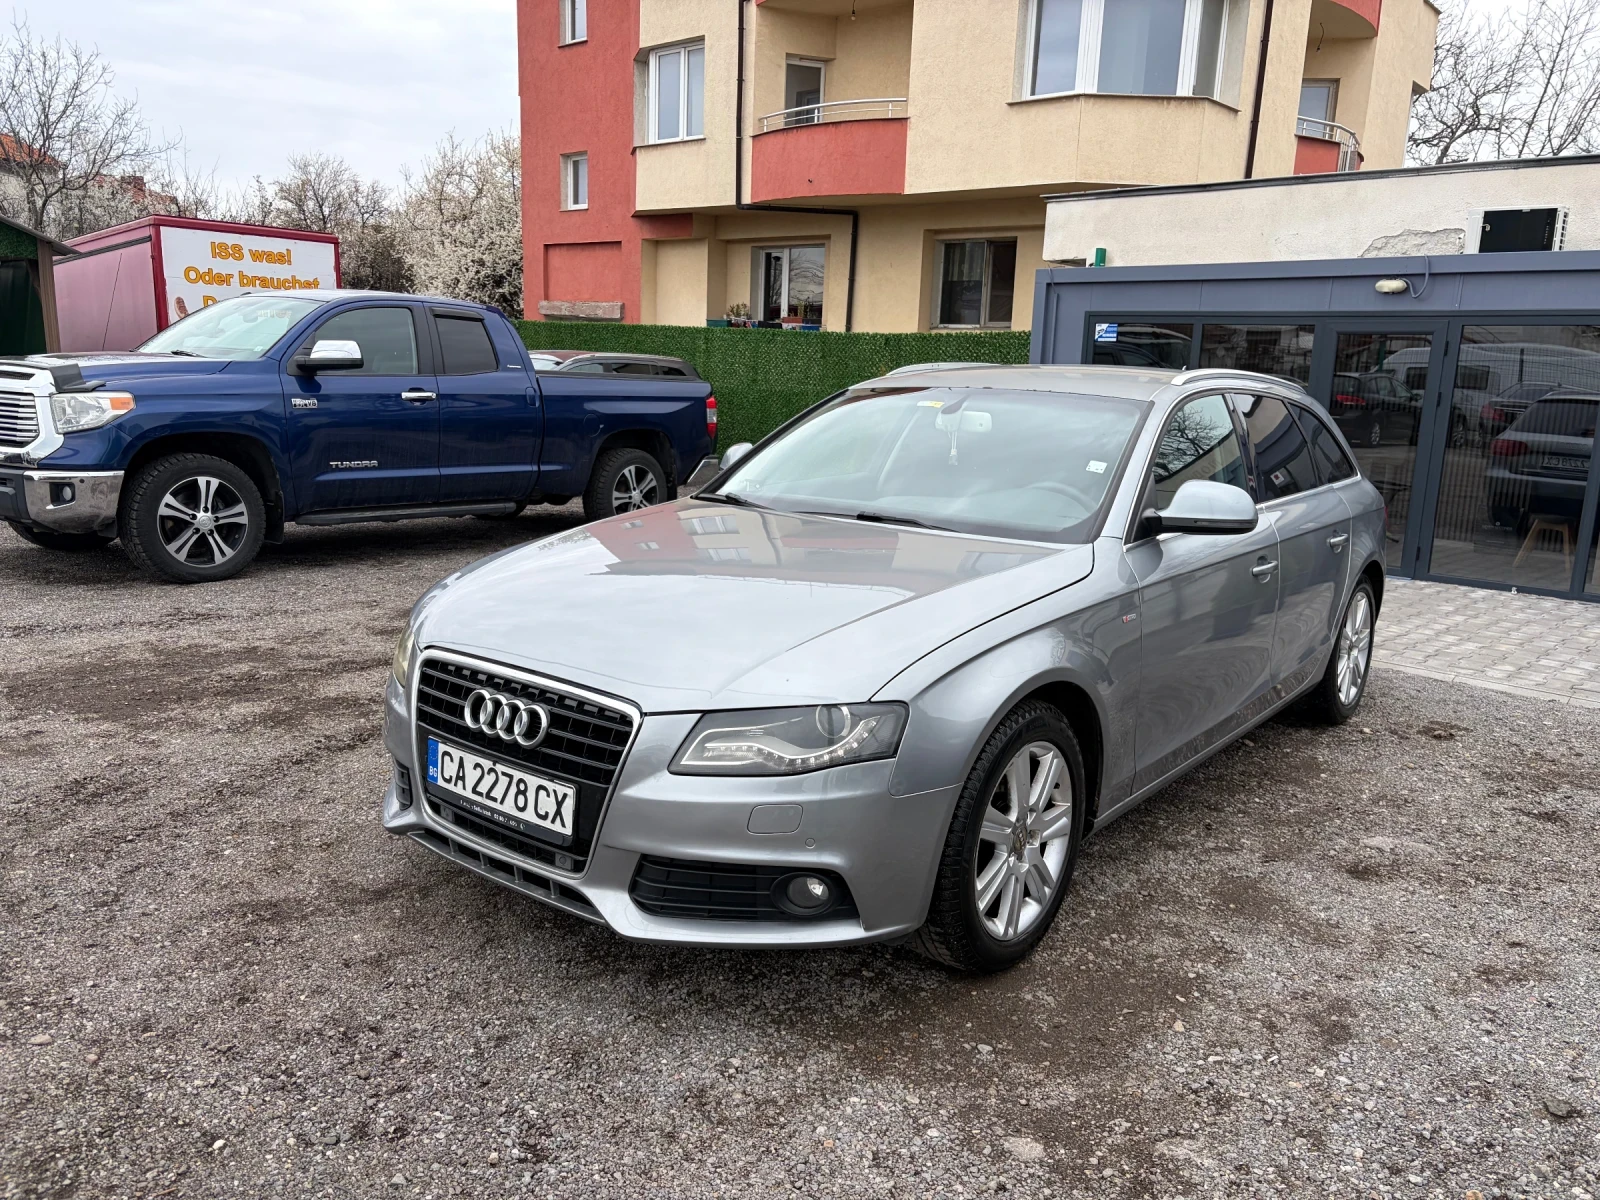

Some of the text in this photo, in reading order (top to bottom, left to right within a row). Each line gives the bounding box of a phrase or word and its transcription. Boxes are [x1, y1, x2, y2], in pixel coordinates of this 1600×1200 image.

[210, 241, 292, 265] ISS was!
[183, 266, 320, 290] Oder brauchst
[329, 461, 378, 469] TUNDRA
[429, 765, 438, 778] BG
[440, 750, 467, 791] CA
[471, 762, 528, 813] 2278
[533, 783, 568, 829] CX
